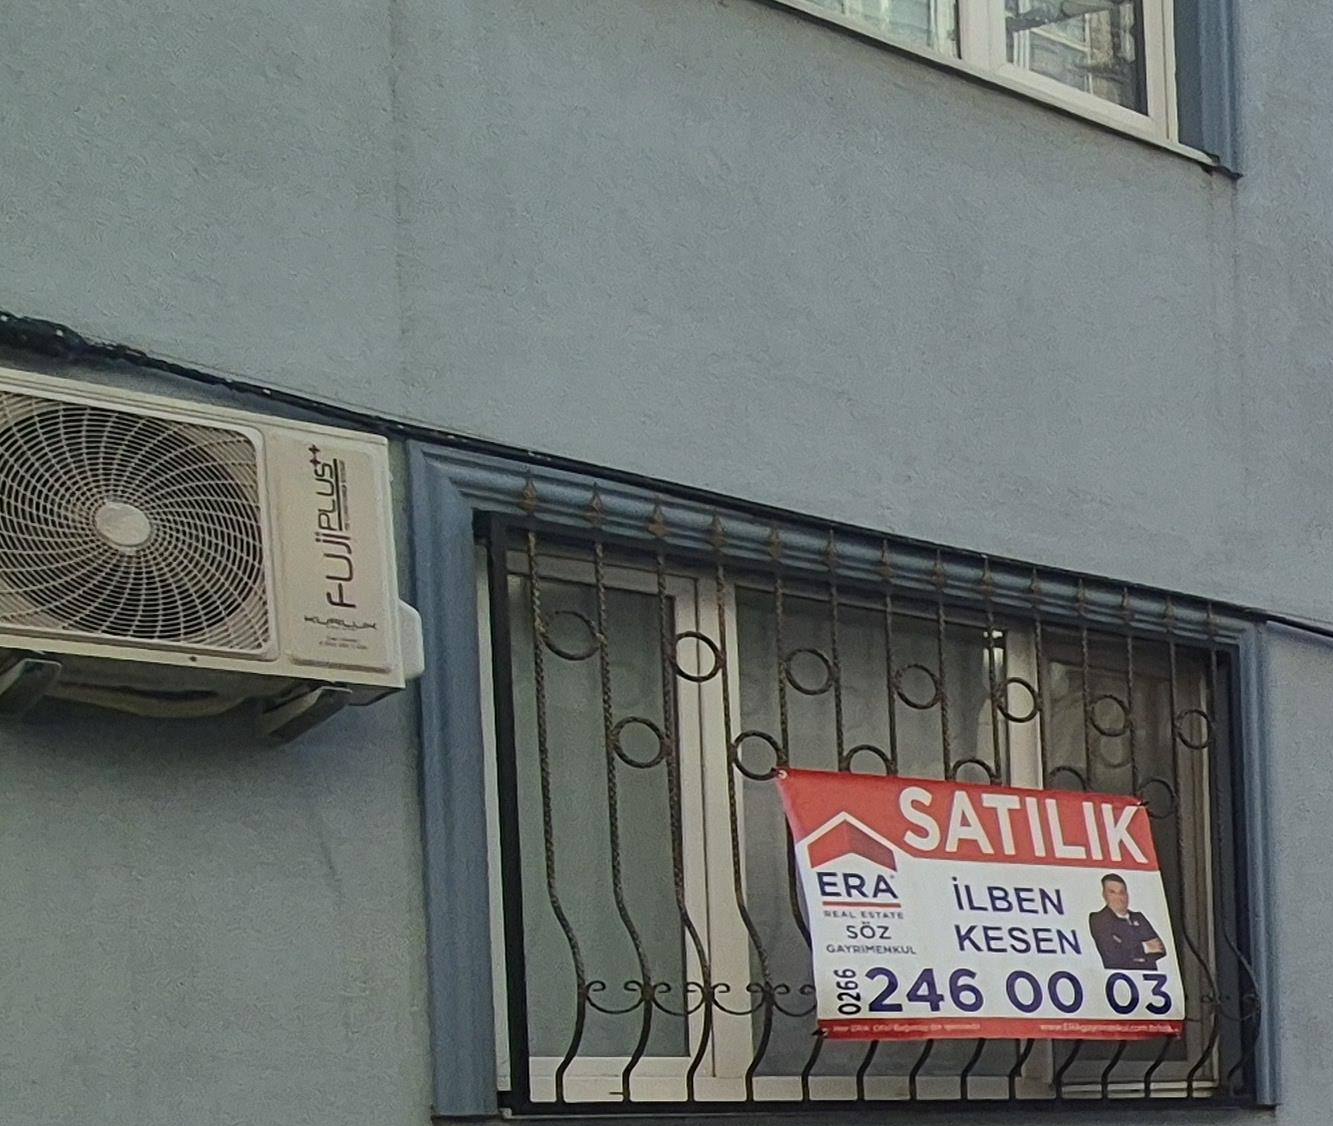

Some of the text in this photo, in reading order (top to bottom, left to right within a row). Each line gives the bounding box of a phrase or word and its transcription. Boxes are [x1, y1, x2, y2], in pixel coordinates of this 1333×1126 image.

[899, 786, 1149, 864] SATILIK
[816, 871, 899, 899] ERA
[951, 876, 1065, 916] İLBEN
[823, 910, 904, 920] REAL ESTATE
[846, 921, 892, 939] SÖZ
[954, 924, 1082, 955] KESEN
[834, 968, 862, 1016] 0266
[865, 967, 1173, 1015] 246 00 03
